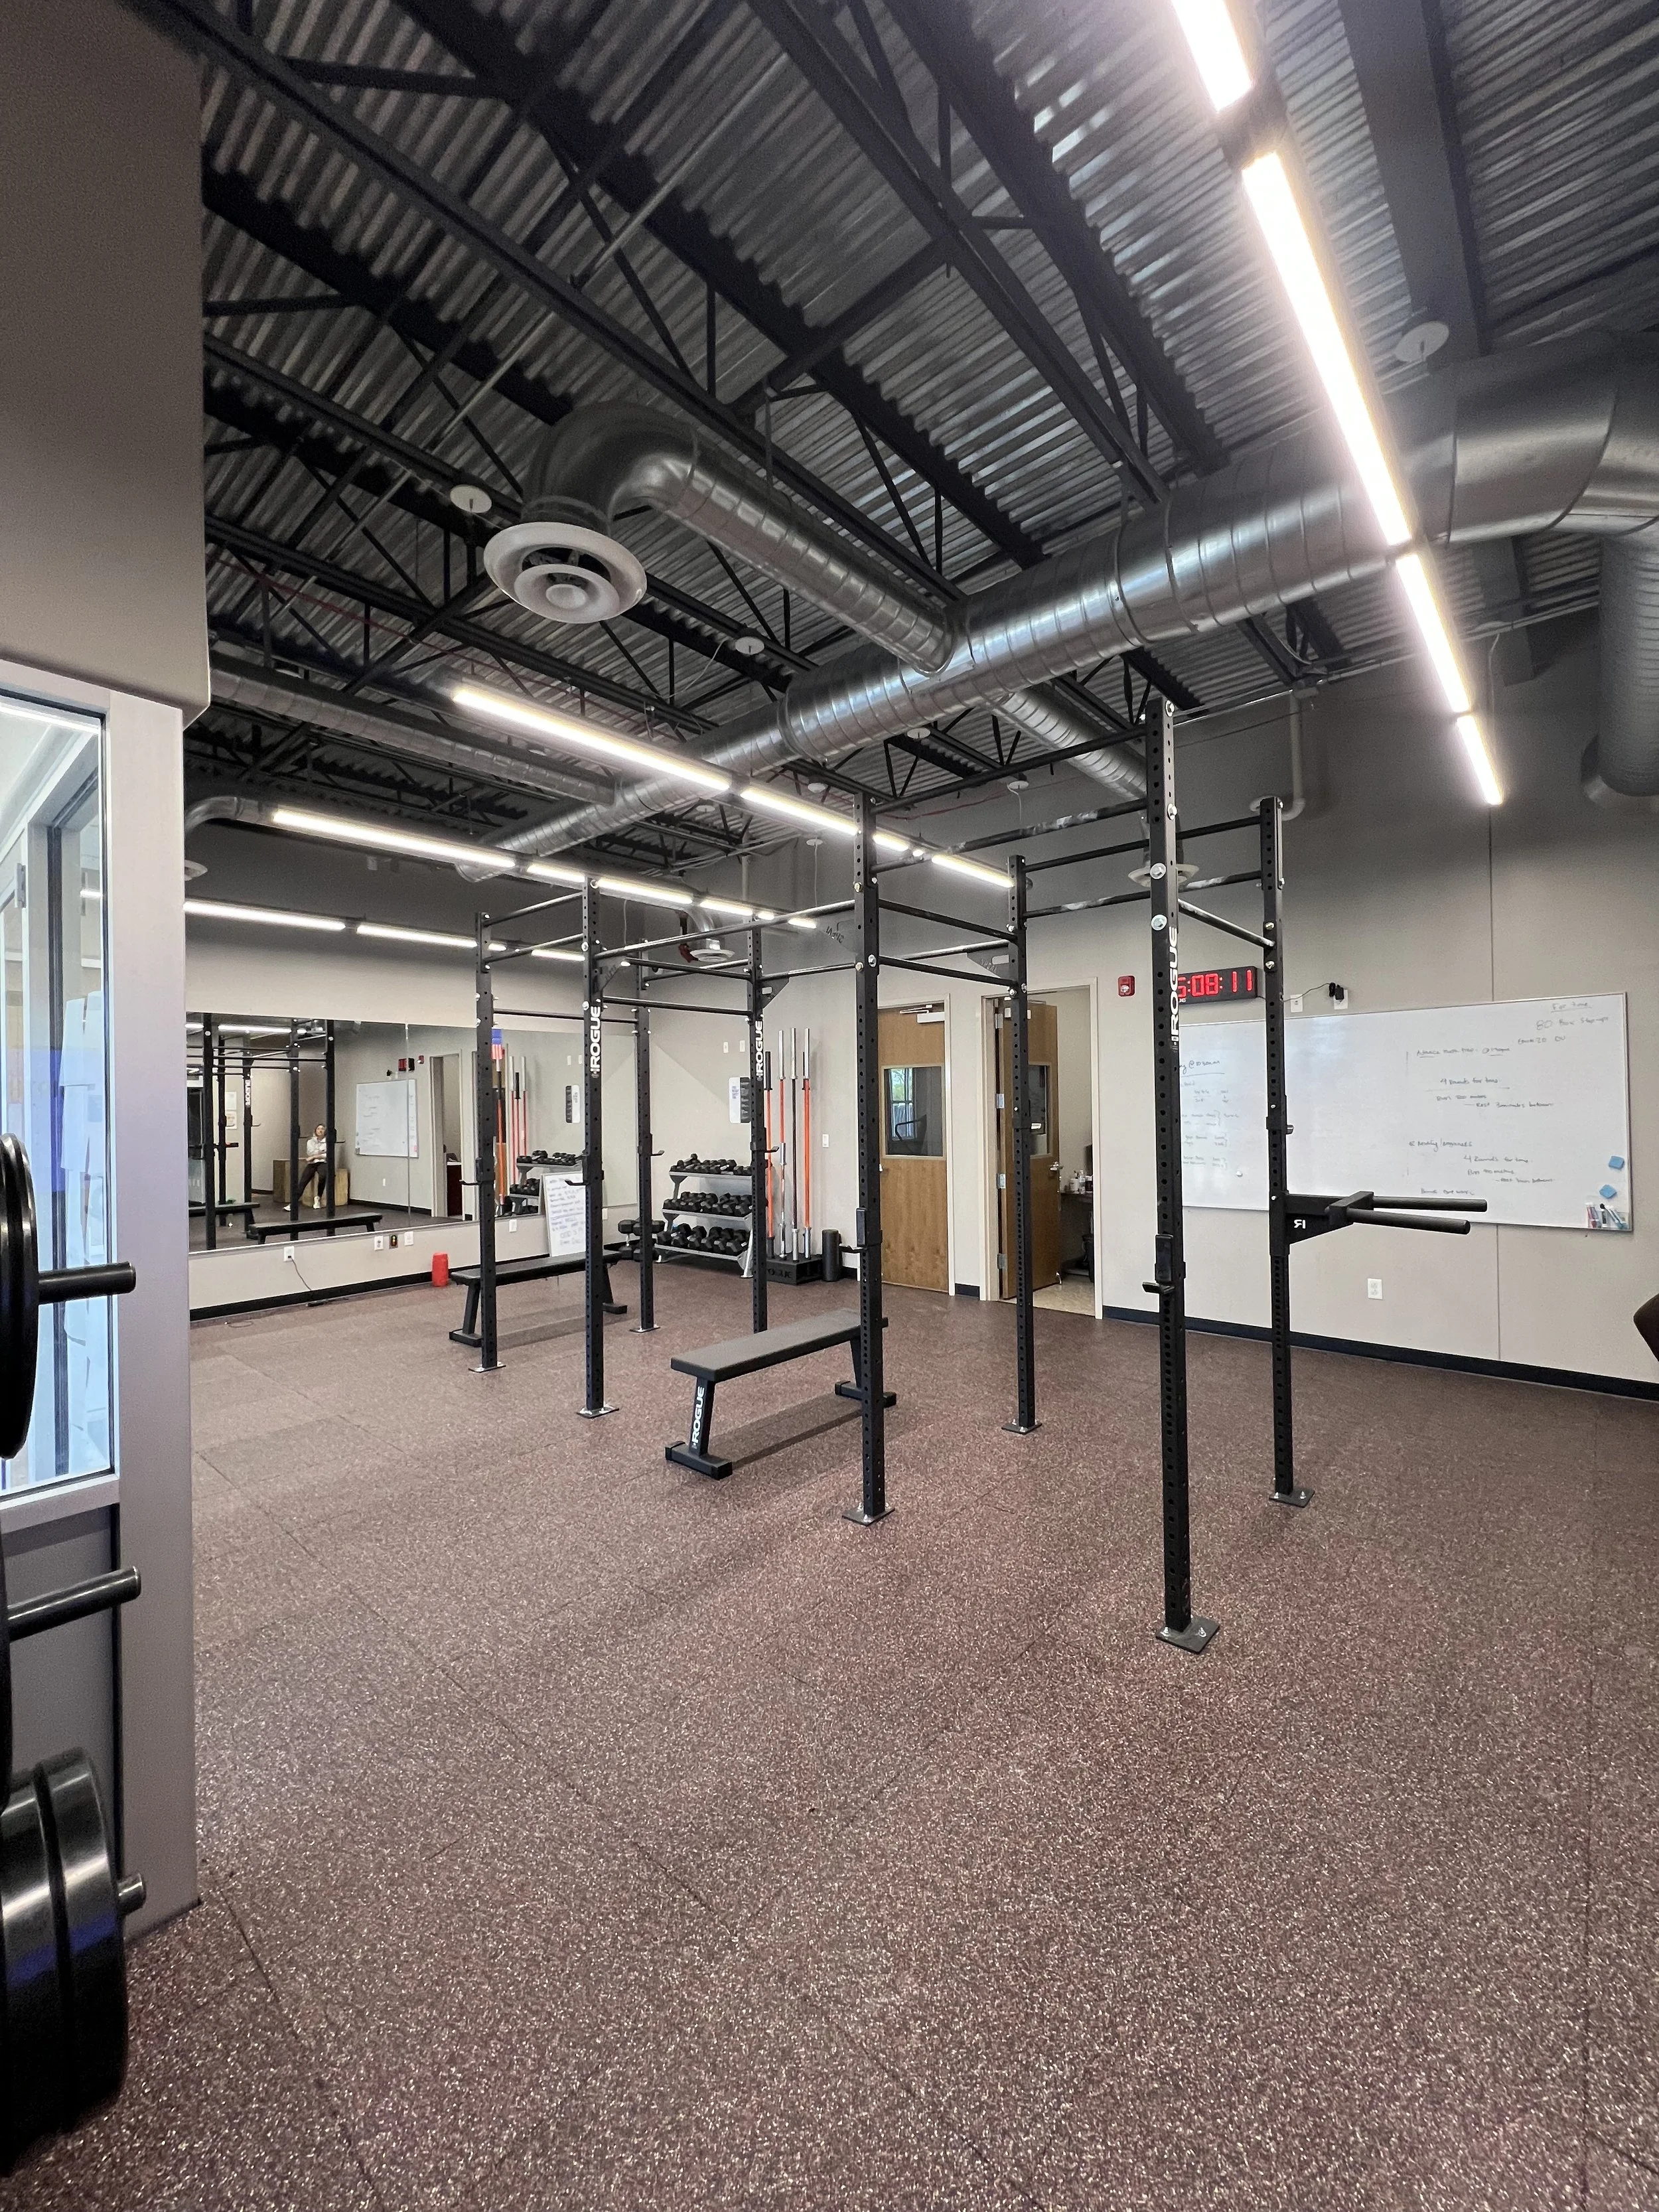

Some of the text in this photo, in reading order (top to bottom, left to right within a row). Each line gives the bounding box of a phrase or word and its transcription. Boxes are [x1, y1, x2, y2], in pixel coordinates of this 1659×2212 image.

[1169, 926, 1179, 1035] ROGUE
[590, 1006, 601, 1069] ROGUE
[691, 1386, 705, 1443] ROGUE
